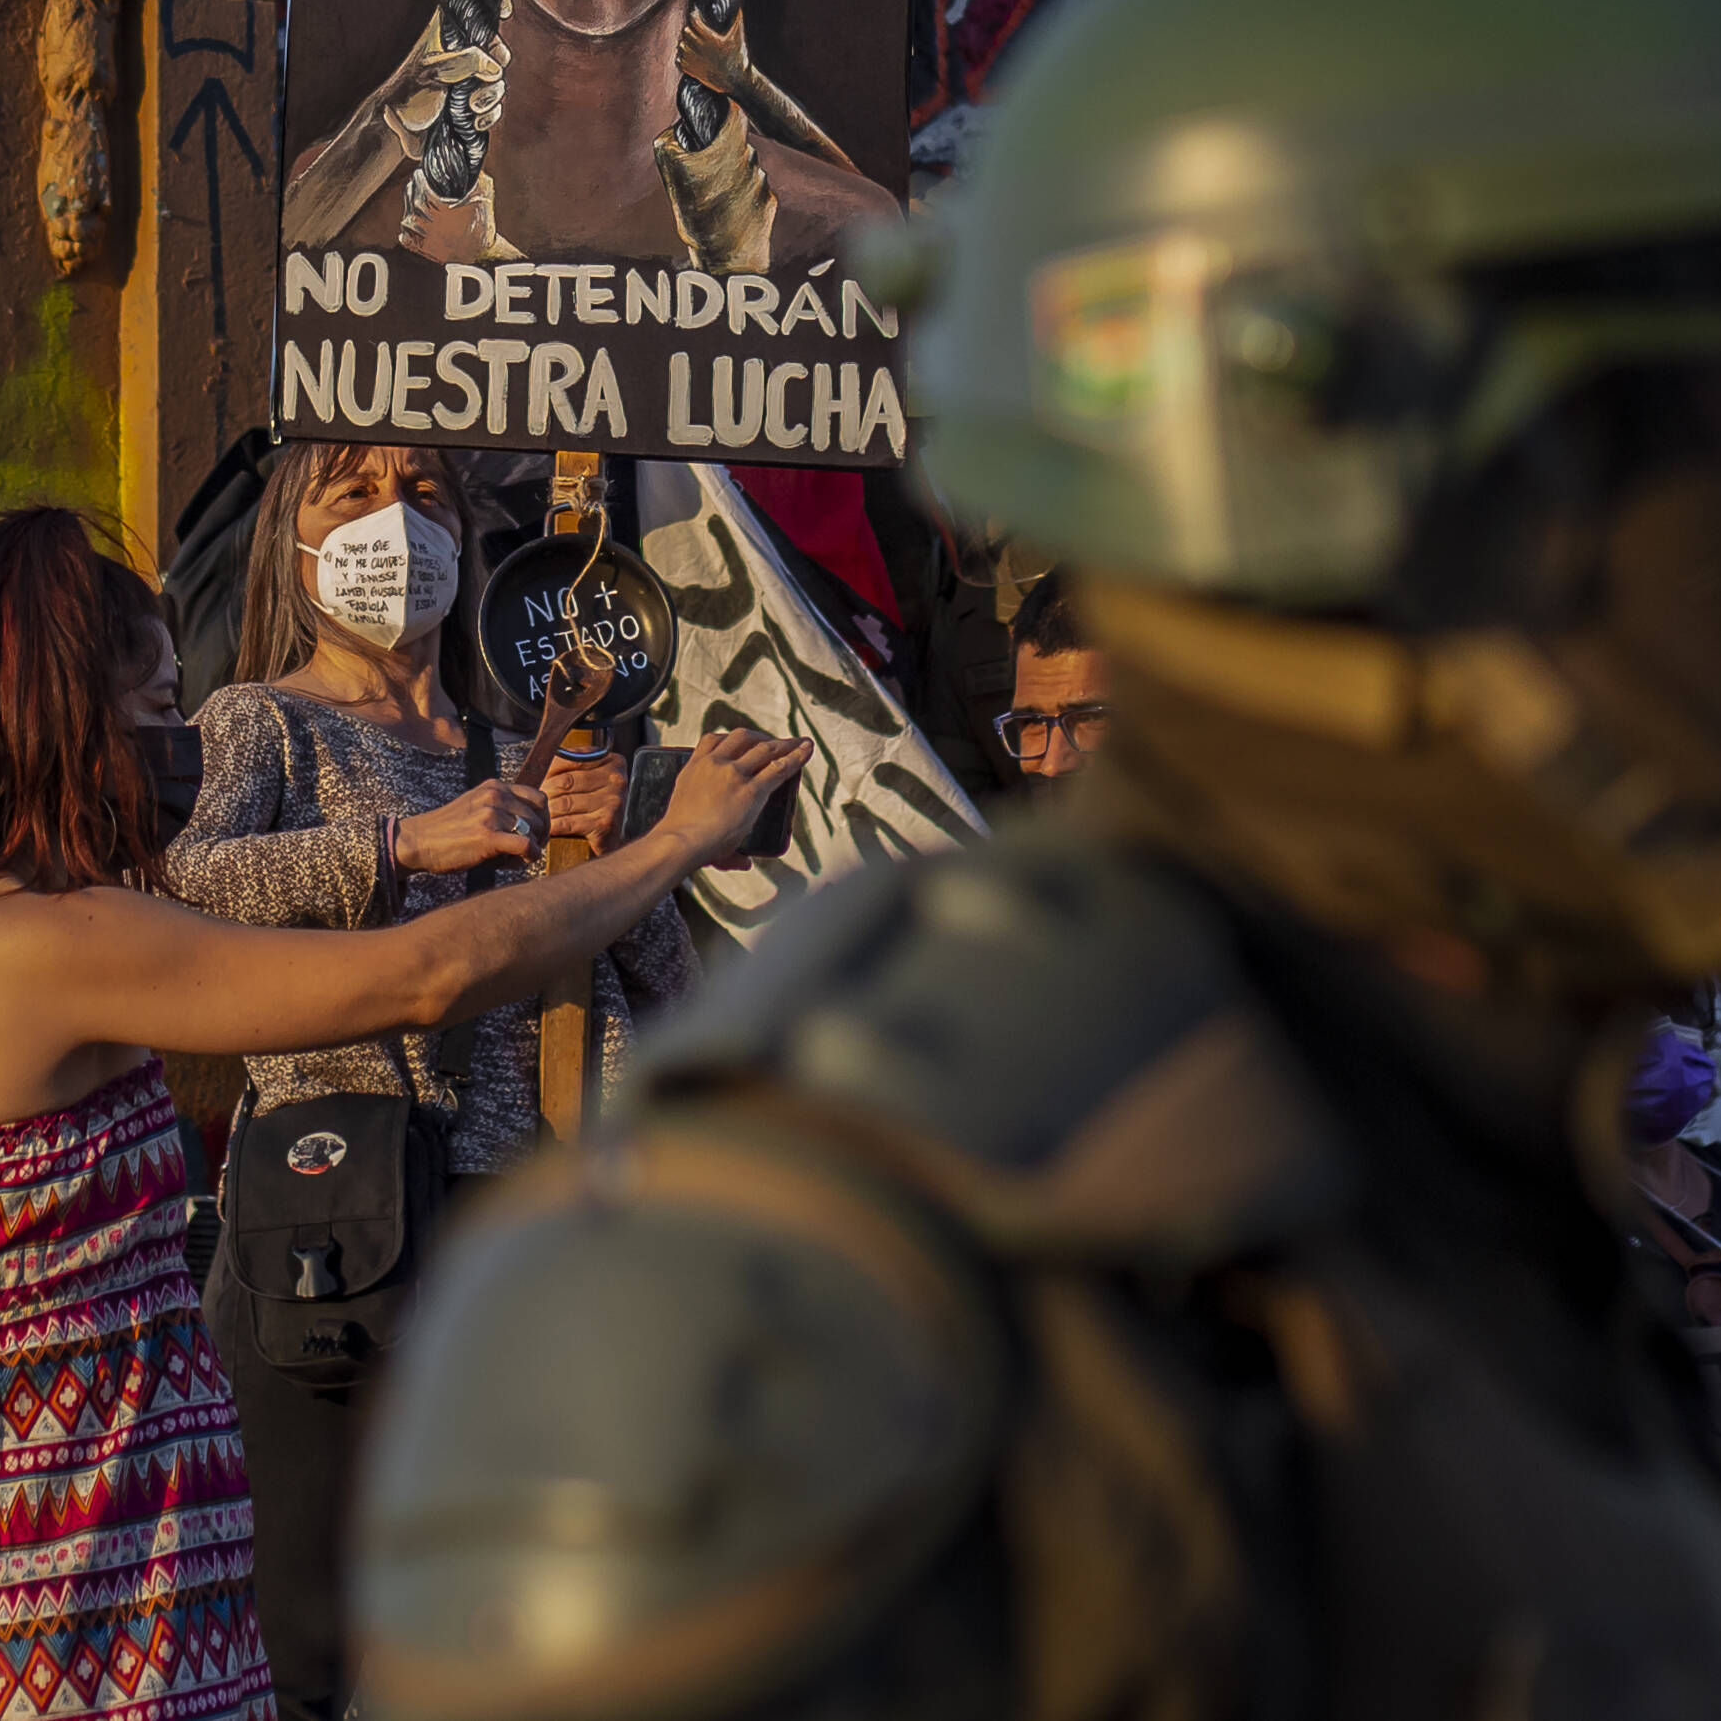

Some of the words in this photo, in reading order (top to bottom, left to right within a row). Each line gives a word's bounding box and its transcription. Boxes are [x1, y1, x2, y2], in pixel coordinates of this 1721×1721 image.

[284, 251, 390, 317] NO
[444, 255, 899, 341] DETENDRÁN
[282, 337, 628, 440] NUESTRA
[669, 352, 906, 461] LUCHA
[514, 614, 640, 667] ESTADO
[522, 586, 579, 628] NO
